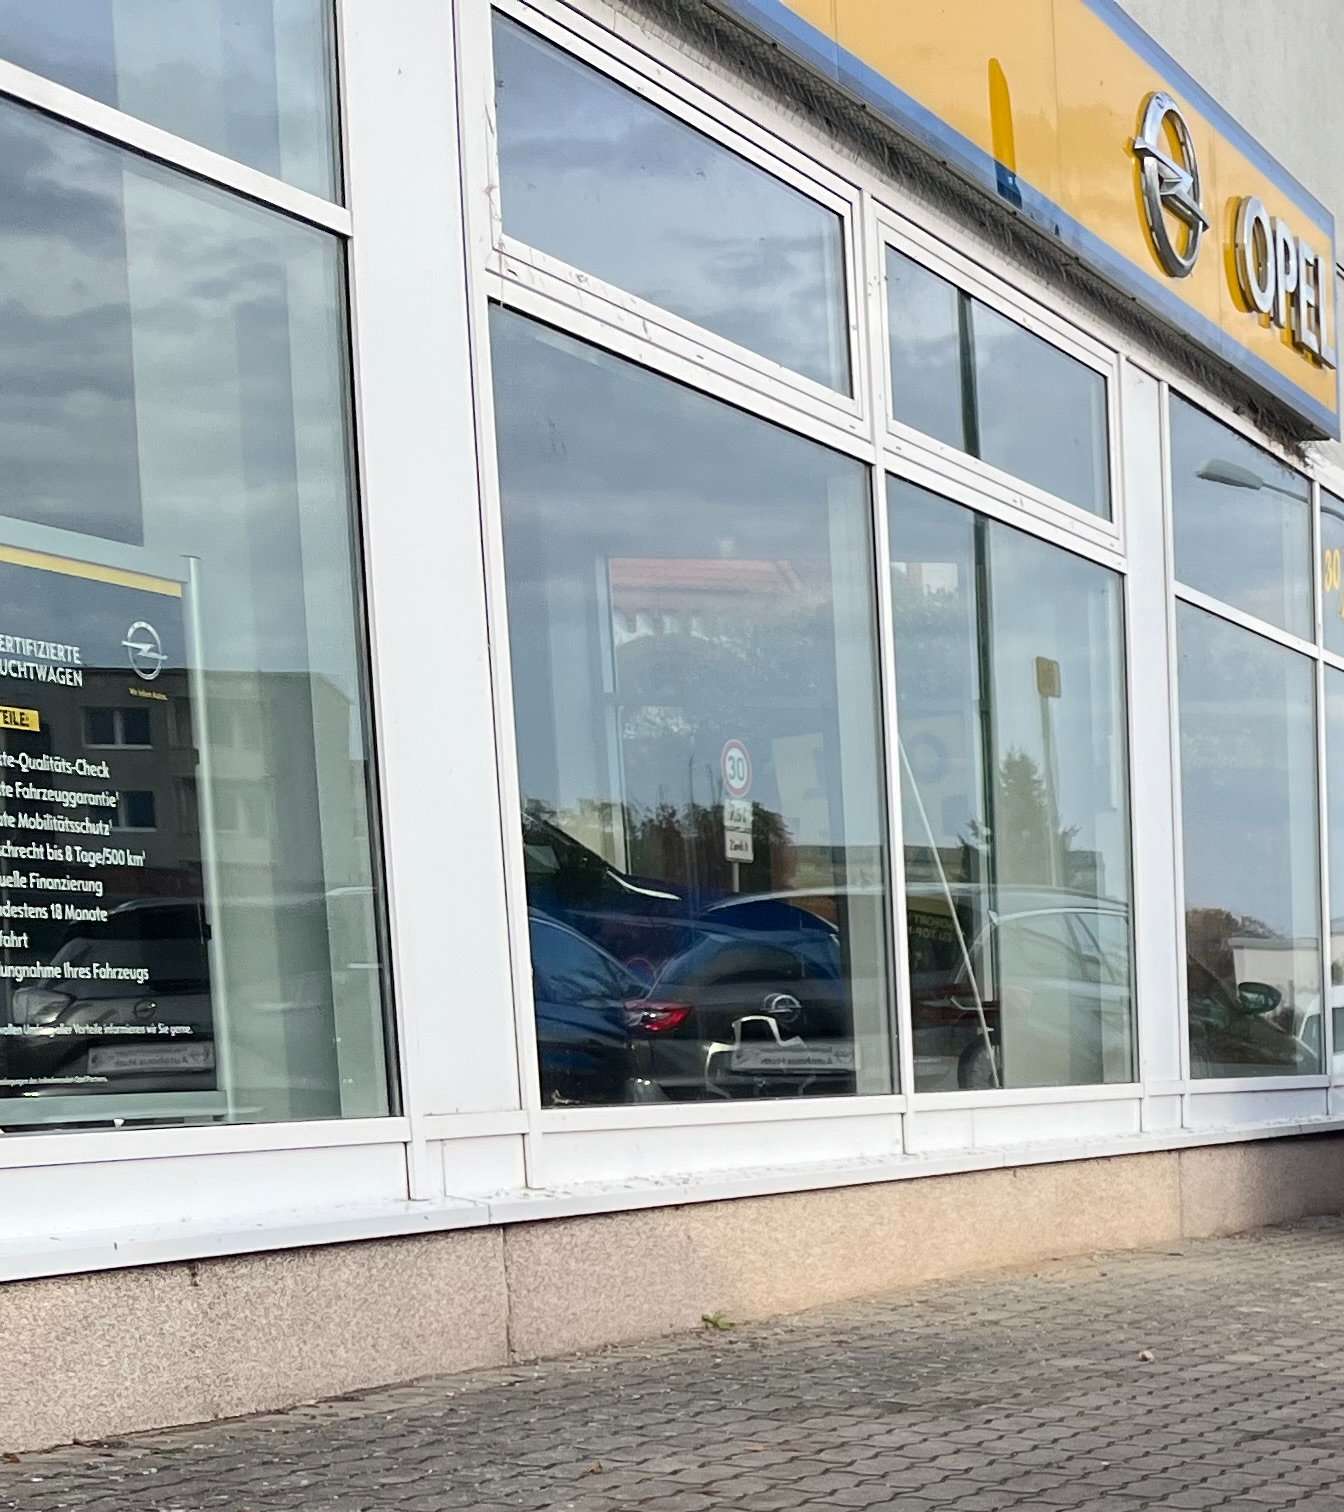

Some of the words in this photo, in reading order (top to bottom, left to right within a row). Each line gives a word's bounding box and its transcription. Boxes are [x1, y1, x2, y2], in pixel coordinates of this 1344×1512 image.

[1237, 196, 1337, 370] OPEL
[1324, 549, 1340, 592] 30
[728, 755, 745, 781] 30
[46, 843, 63, 861] bis
[65, 845, 73, 862] 8
[29, 872, 103, 897] Finanzierung
[50, 903, 62, 920] 18
[65, 904, 108, 922] Monate
[64, 961, 91, 979] Ihres
[93, 962, 149, 984] Fahrzeugs
